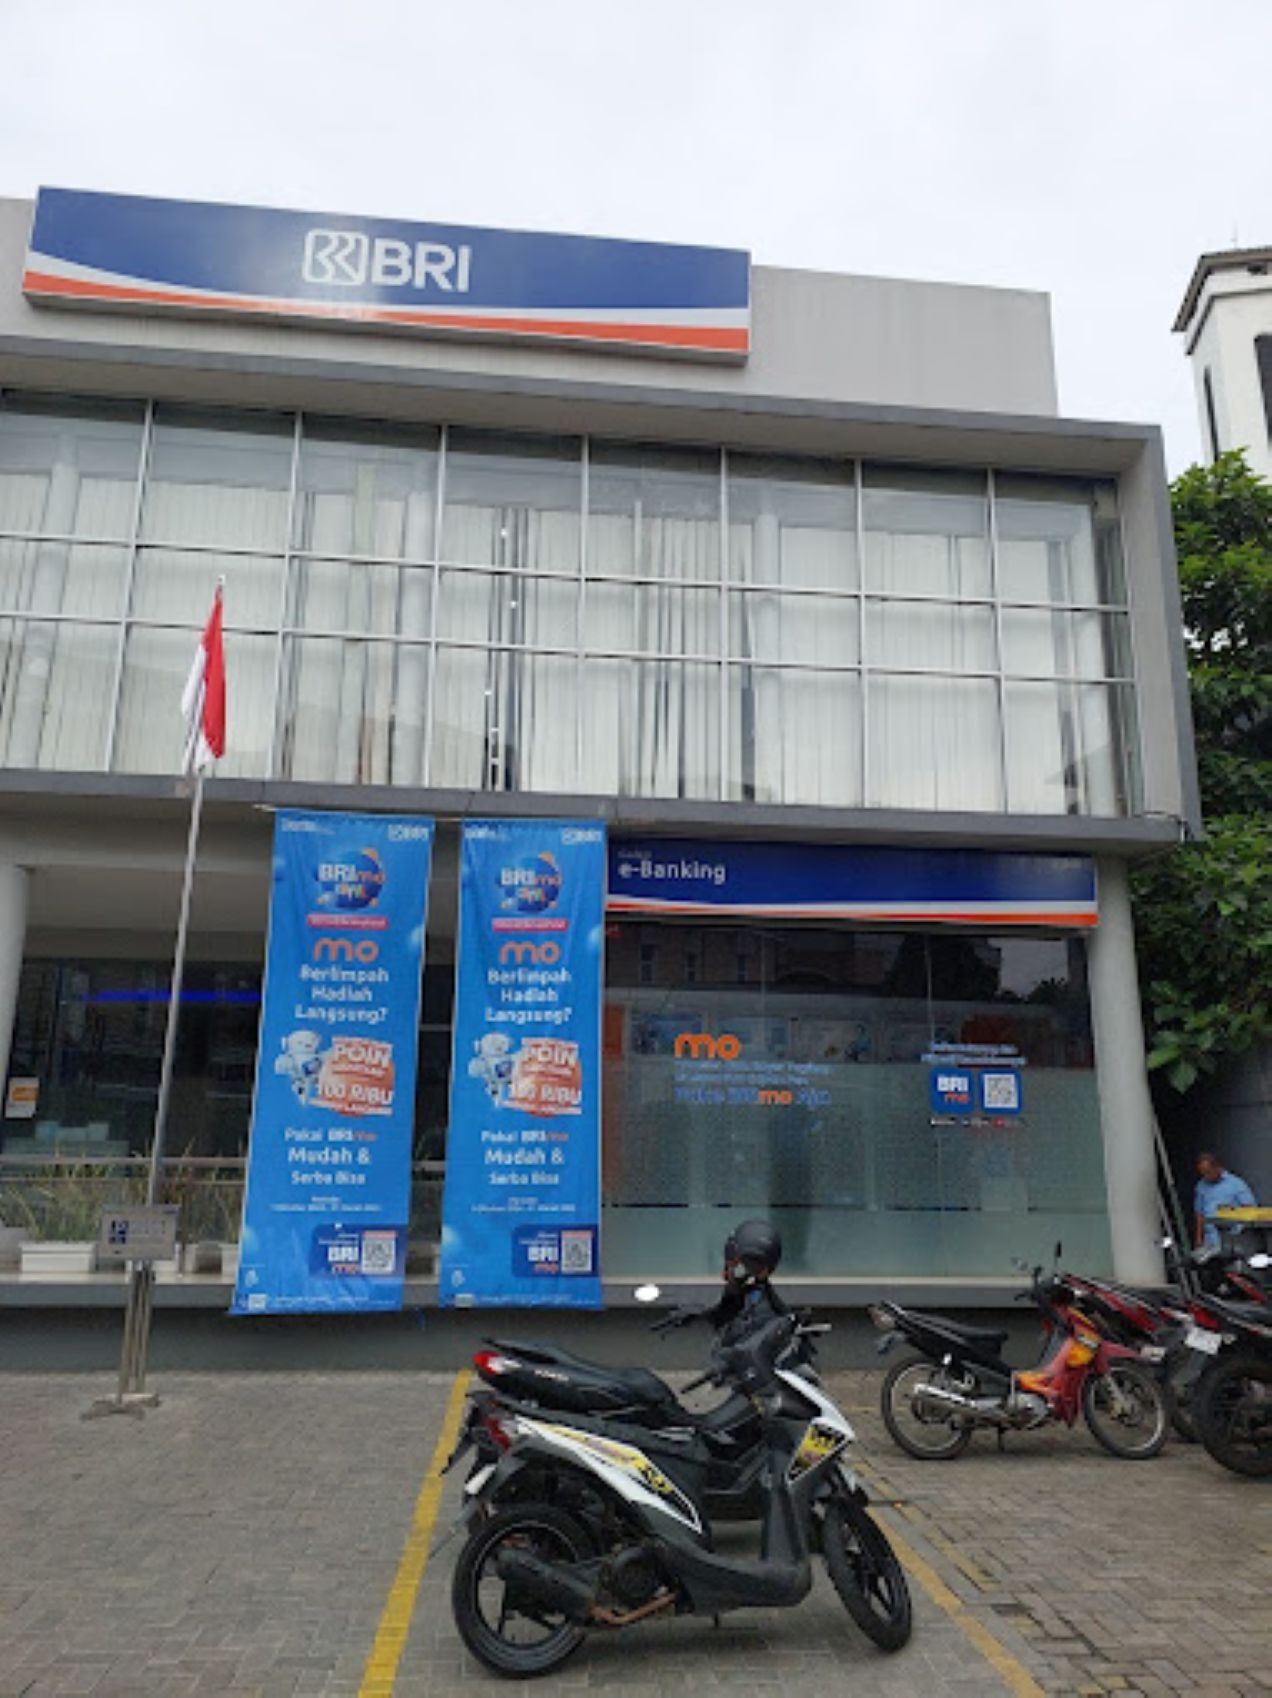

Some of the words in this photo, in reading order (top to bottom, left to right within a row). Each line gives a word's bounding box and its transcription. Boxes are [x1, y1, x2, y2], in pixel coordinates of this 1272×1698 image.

[371, 237, 472, 293] BRI
[618, 860, 726, 886] e-Banking
[313, 937, 379, 963] mo
[499, 940, 560, 964] mo
[300, 964, 389, 984] Berlimpah
[487, 967, 572, 985] Berlimpah
[311, 984, 373, 1001] Hadiah
[501, 987, 559, 1002] Hadiah
[295, 1004, 388, 1025] Langsung?
[484, 1007, 572, 1025] Langsung?
[673, 1033, 741, 1061] mo
[288, 1147, 353, 1164] Mudah
[357, 1146, 371, 1165] &
[485, 1147, 546, 1165] Mudah
[551, 1147, 565, 1165] &
[291, 1170, 332, 1185] Serba
